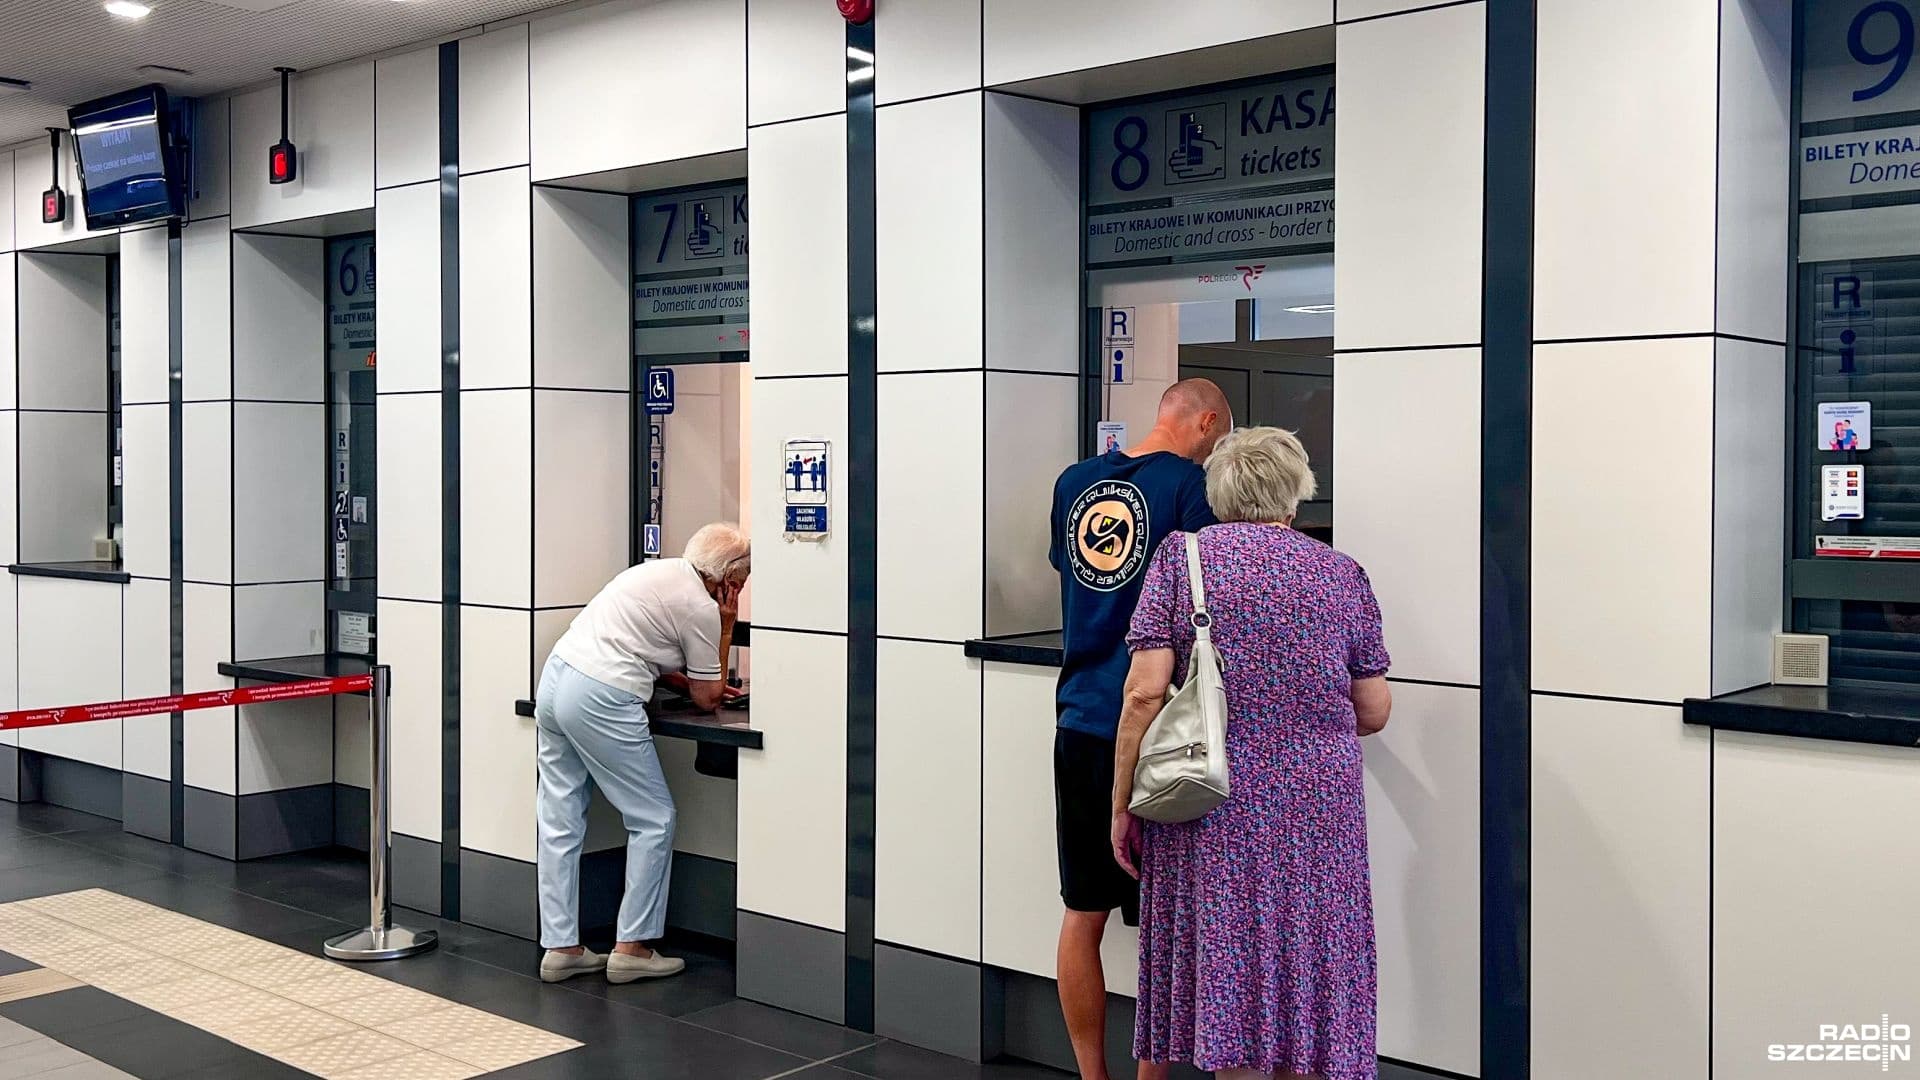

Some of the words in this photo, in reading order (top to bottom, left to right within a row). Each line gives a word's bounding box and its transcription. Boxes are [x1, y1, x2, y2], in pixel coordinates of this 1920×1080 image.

[1847, 1, 1915, 102] 9
[1240, 86, 1335, 137] KASA
[274, 153, 286, 177] 6
[1111, 116, 1149, 192] 8
[1240, 145, 1321, 177] tickets
[1806, 142, 1870, 162] BILETY
[47, 197, 56, 216] 5
[1089, 221, 1127, 236] BILETY
[1129, 215, 1184, 231] KRAJOWE
[1187, 213, 1191, 225] I
[1193, 213, 1204, 225] W
[1207, 203, 1293, 224] KOMUNIKACJI
[653, 203, 678, 263] 7
[1115, 232, 1180, 253] Domestic
[1184, 227, 1214, 246] and
[1217, 228, 1255, 243] cross
[1270, 218, 1322, 238] border
[340, 246, 358, 296] 6
[1198, 273, 1238, 283] POLREGIO
[636, 288, 660, 298] BILETY
[662, 284, 698, 296] KRAJOWE
[704, 283, 712, 292] W
[653, 297, 695, 313] Domestic
[698, 295, 718, 309] and
[720, 296, 744, 308] cross
[1833, 276, 1861, 309] R
[334, 313, 355, 325] BILETY
[1112, 311, 1127, 335] R
[1839, 329, 1857, 373] i
[1113, 350, 1124, 382] i
[339, 432, 346, 447] R
[651, 425, 660, 444] R
[340, 463, 345, 483] i
